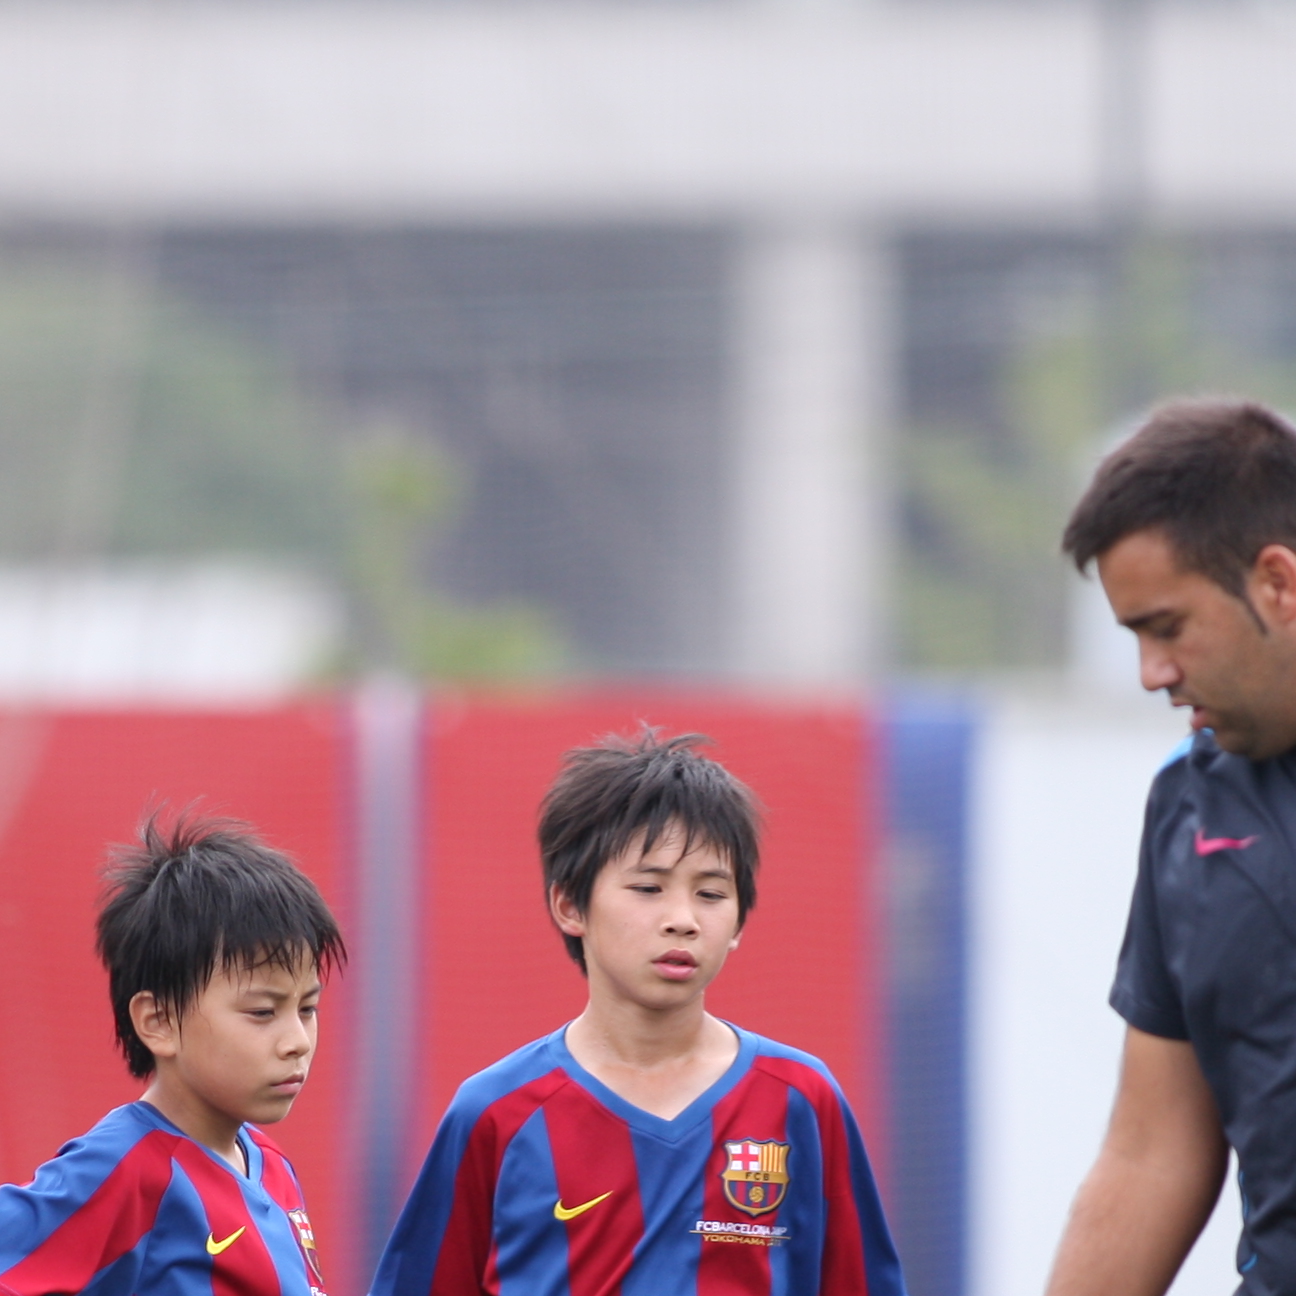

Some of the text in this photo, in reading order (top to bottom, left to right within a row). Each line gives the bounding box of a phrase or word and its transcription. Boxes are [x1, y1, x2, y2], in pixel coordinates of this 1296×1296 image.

[744, 1171, 770, 1181] FCB
[695, 1220, 770, 1236] FCBARCELONA
[702, 1234, 766, 1246] YOKOHAMA
